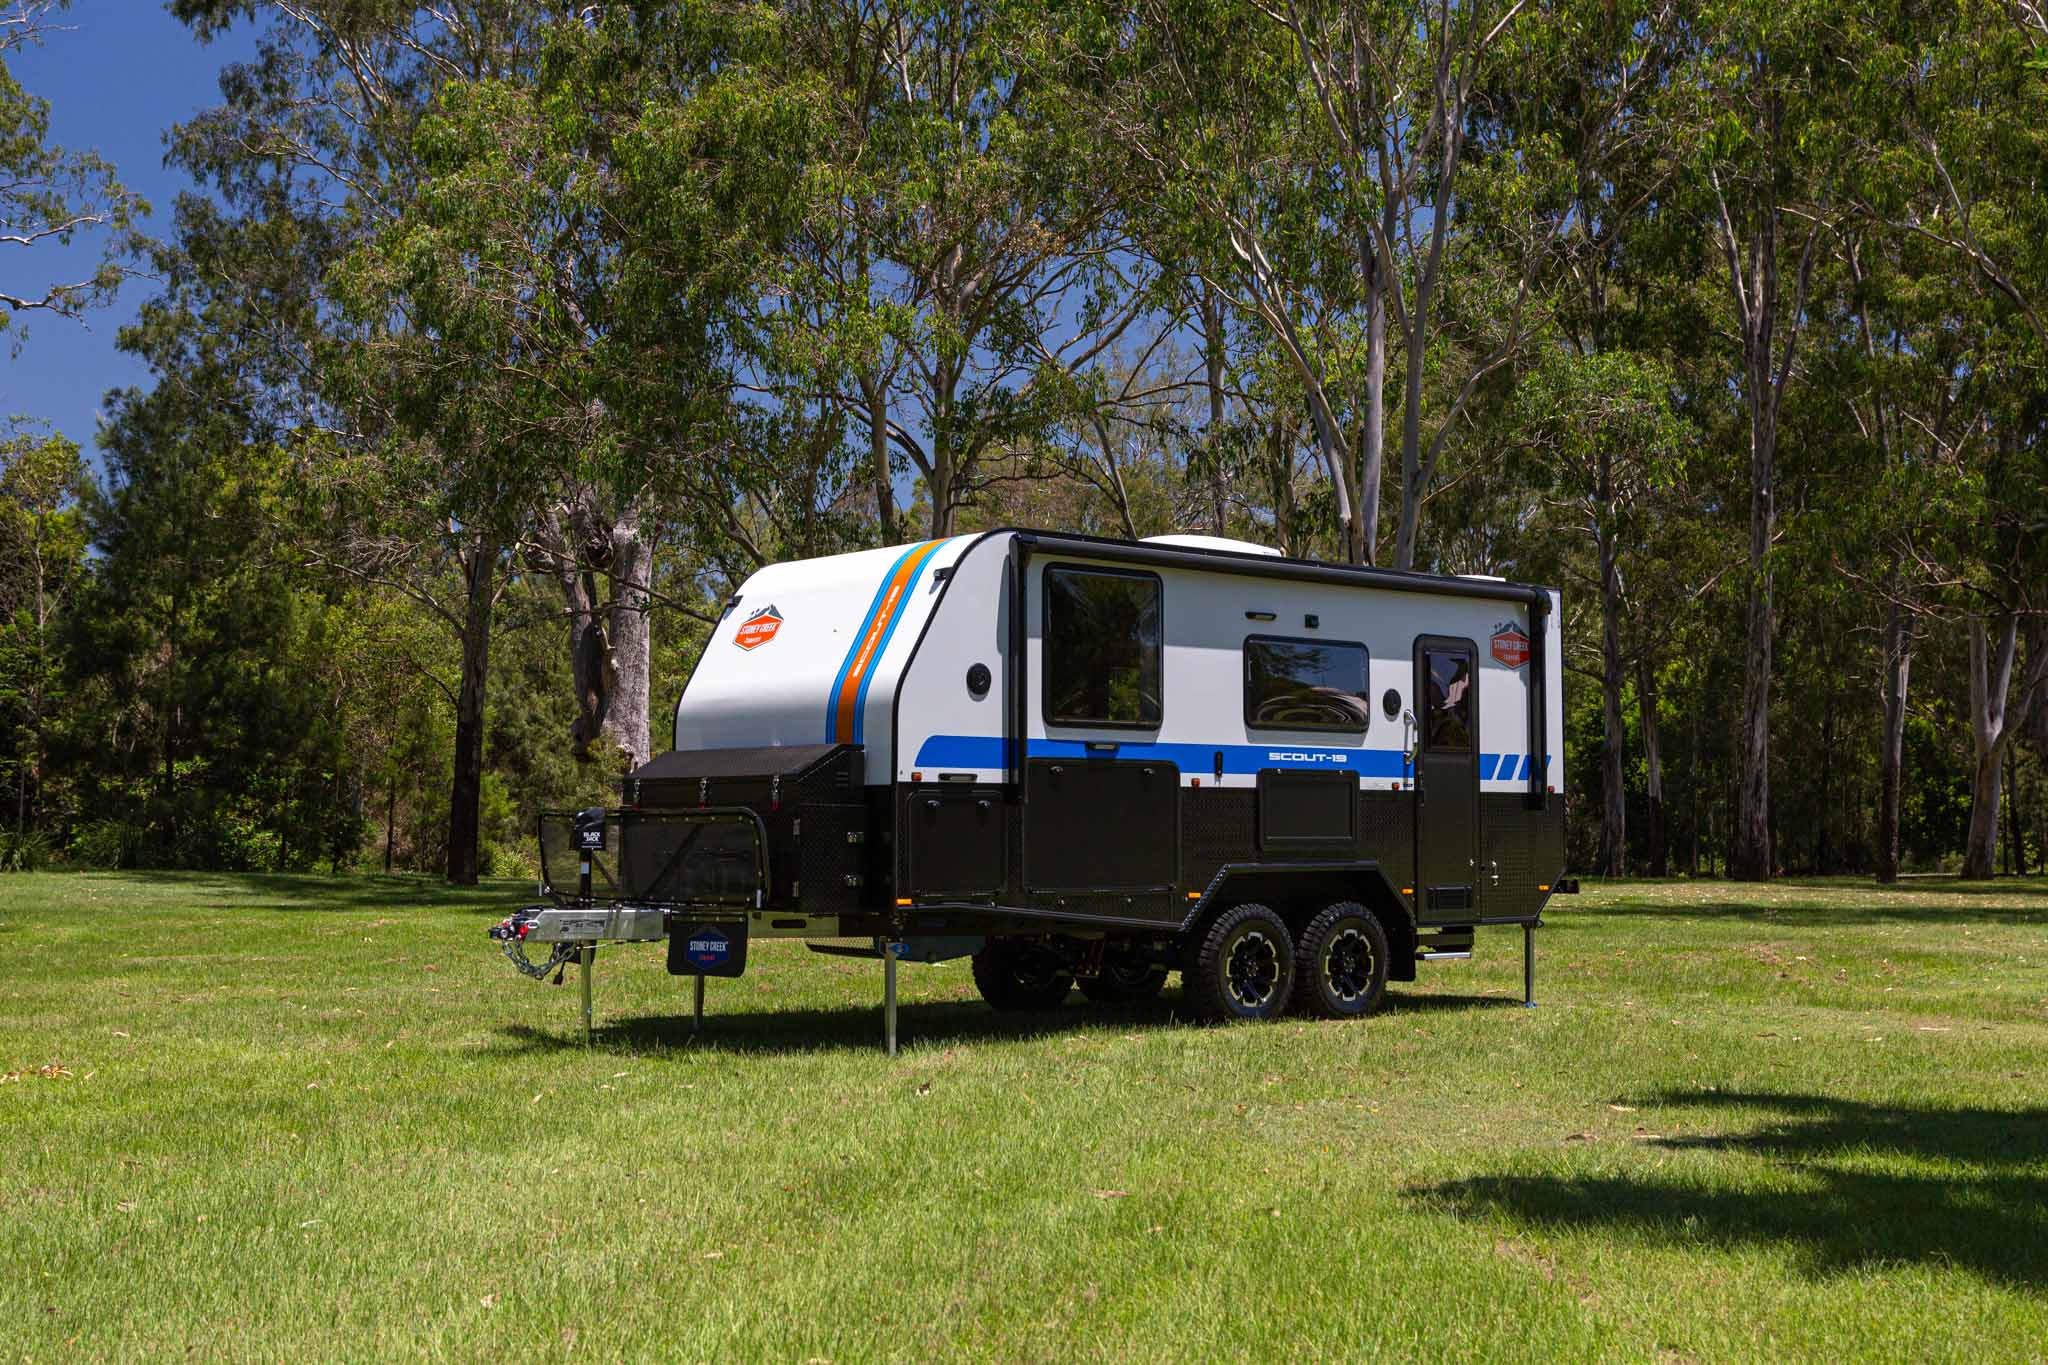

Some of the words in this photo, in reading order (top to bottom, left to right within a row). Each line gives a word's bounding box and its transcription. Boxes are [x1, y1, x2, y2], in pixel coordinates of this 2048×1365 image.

[1268, 752, 1347, 763] SCOUT-19
[690, 941, 709, 951] STONEY
[710, 941, 726, 951] CREEK
